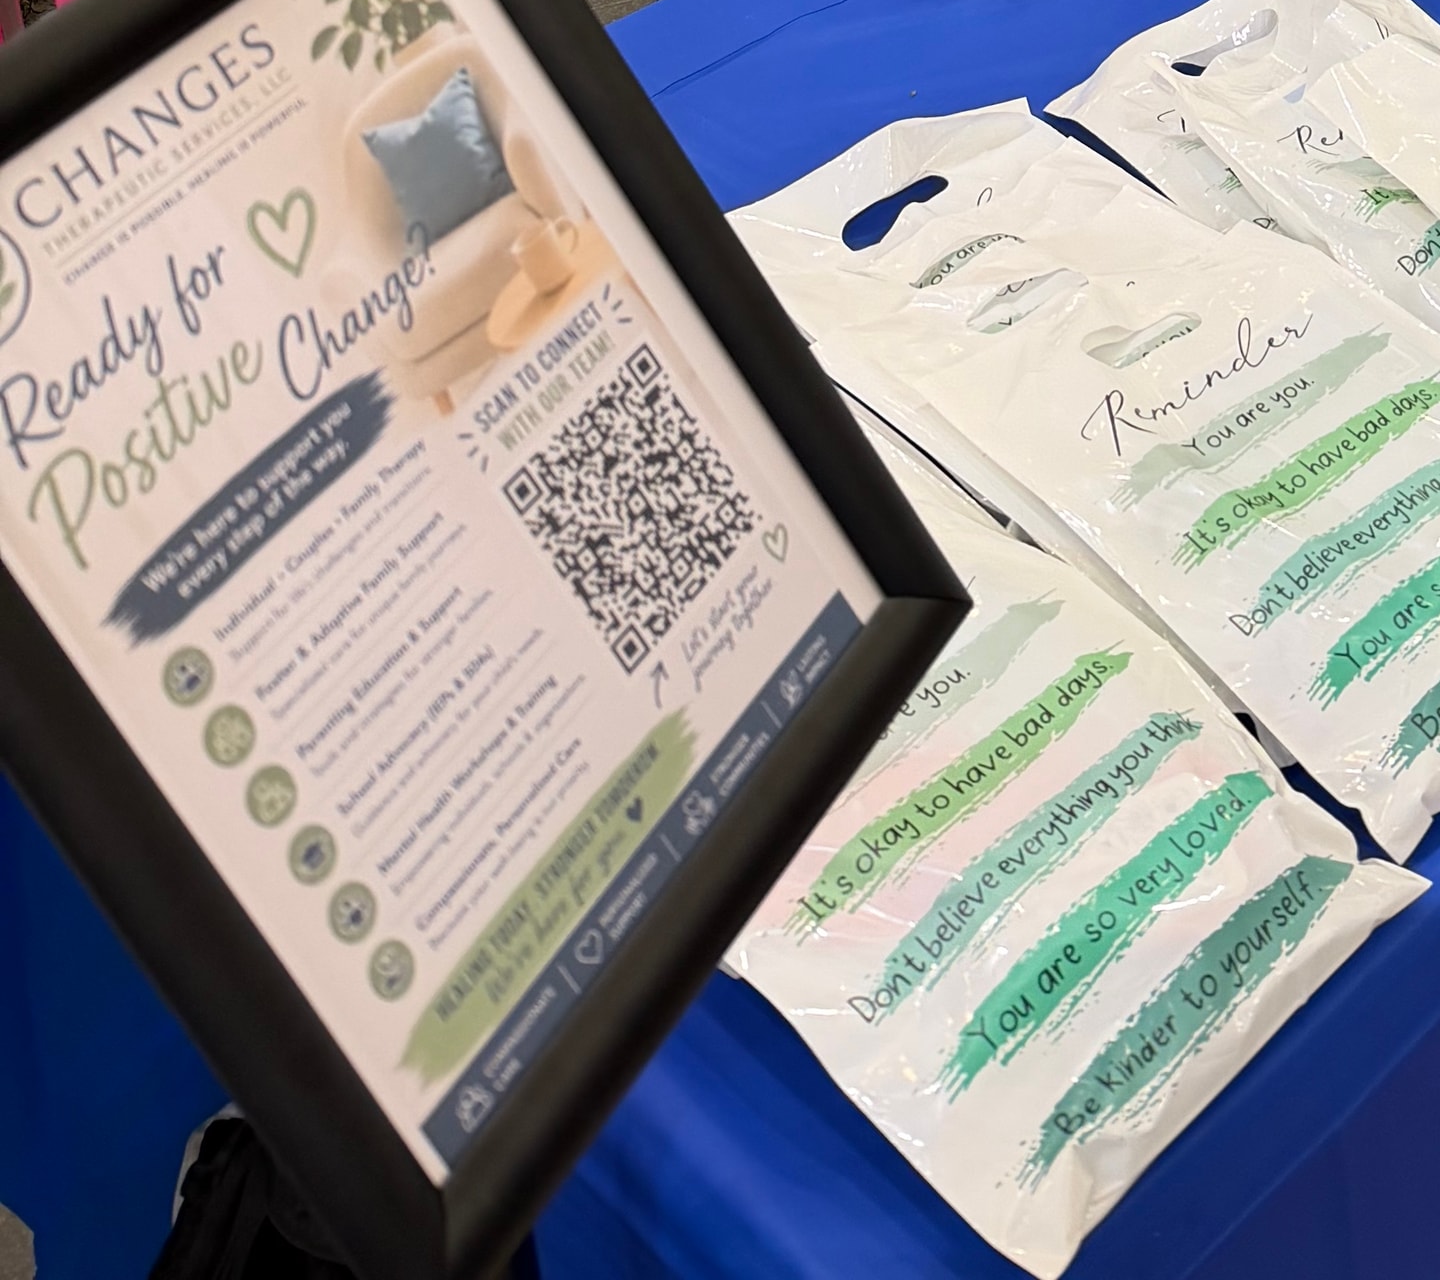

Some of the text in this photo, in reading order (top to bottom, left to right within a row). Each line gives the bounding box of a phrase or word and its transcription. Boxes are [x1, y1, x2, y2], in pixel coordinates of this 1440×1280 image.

[15, 23, 275, 229] CHANGES
[1, 245, 226, 470] Ready for
[28, 339, 265, 571] Positive
[279, 222, 437, 400] Change?
[474, 302, 603, 434] SCAN TO CONNECT
[498, 330, 616, 451] WITH OUR TEAM!
[1080, 313, 1314, 457] Reminder
[1181, 378, 1315, 457] You are you.
[257, 429, 321, 491] support
[1183, 387, 1438, 556] It's okay to have bad days.
[226, 514, 266, 554] step
[1229, 582, 1295, 637] Don't
[1294, 537, 1356, 591] believe
[919, 669, 970, 709] you.
[1333, 630, 1393, 669] You
[1393, 592, 1430, 629] are
[798, 660, 1114, 921] It's okay to have bad days.
[847, 956, 926, 1024] Don't
[922, 871, 1000, 959] believe
[999, 779, 1117, 876] everything
[1113, 744, 1155, 793] you
[966, 796, 1251, 1056] You are so very loved.
[1054, 869, 1323, 1136] Be kinder to yourself.
